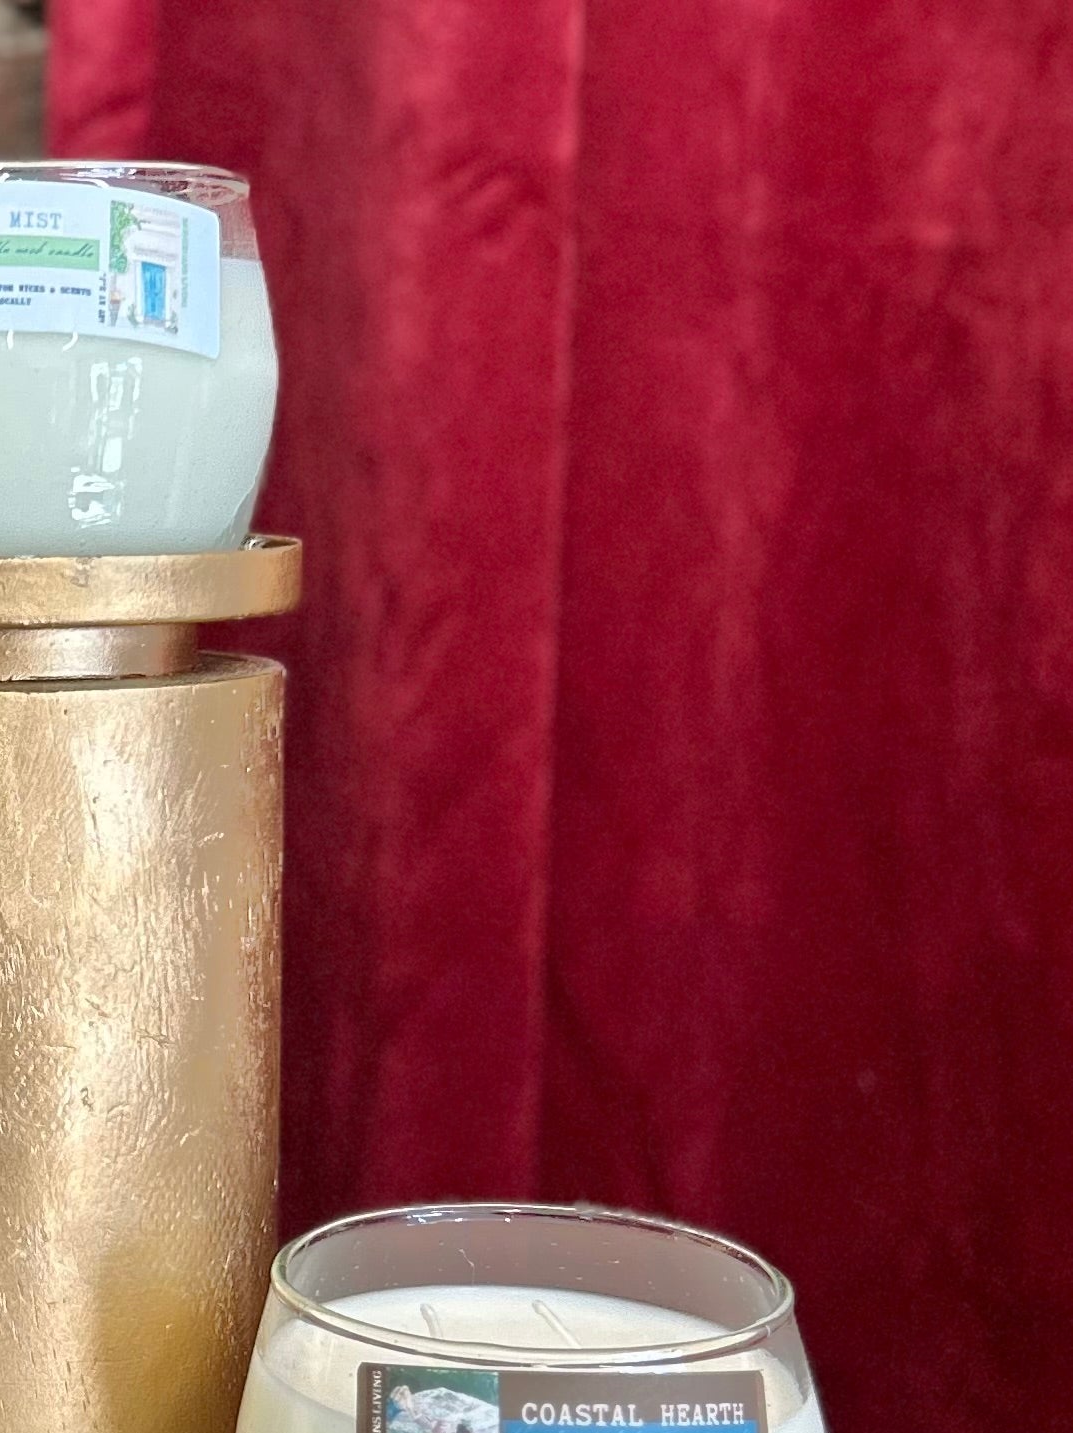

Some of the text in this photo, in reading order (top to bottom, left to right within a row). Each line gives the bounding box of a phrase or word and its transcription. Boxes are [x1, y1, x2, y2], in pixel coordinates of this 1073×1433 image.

[9, 210, 63, 231] MIST
[371, 1369, 383, 1415] LIVING
[521, 1402, 745, 1427] COASTAL HEARTH
